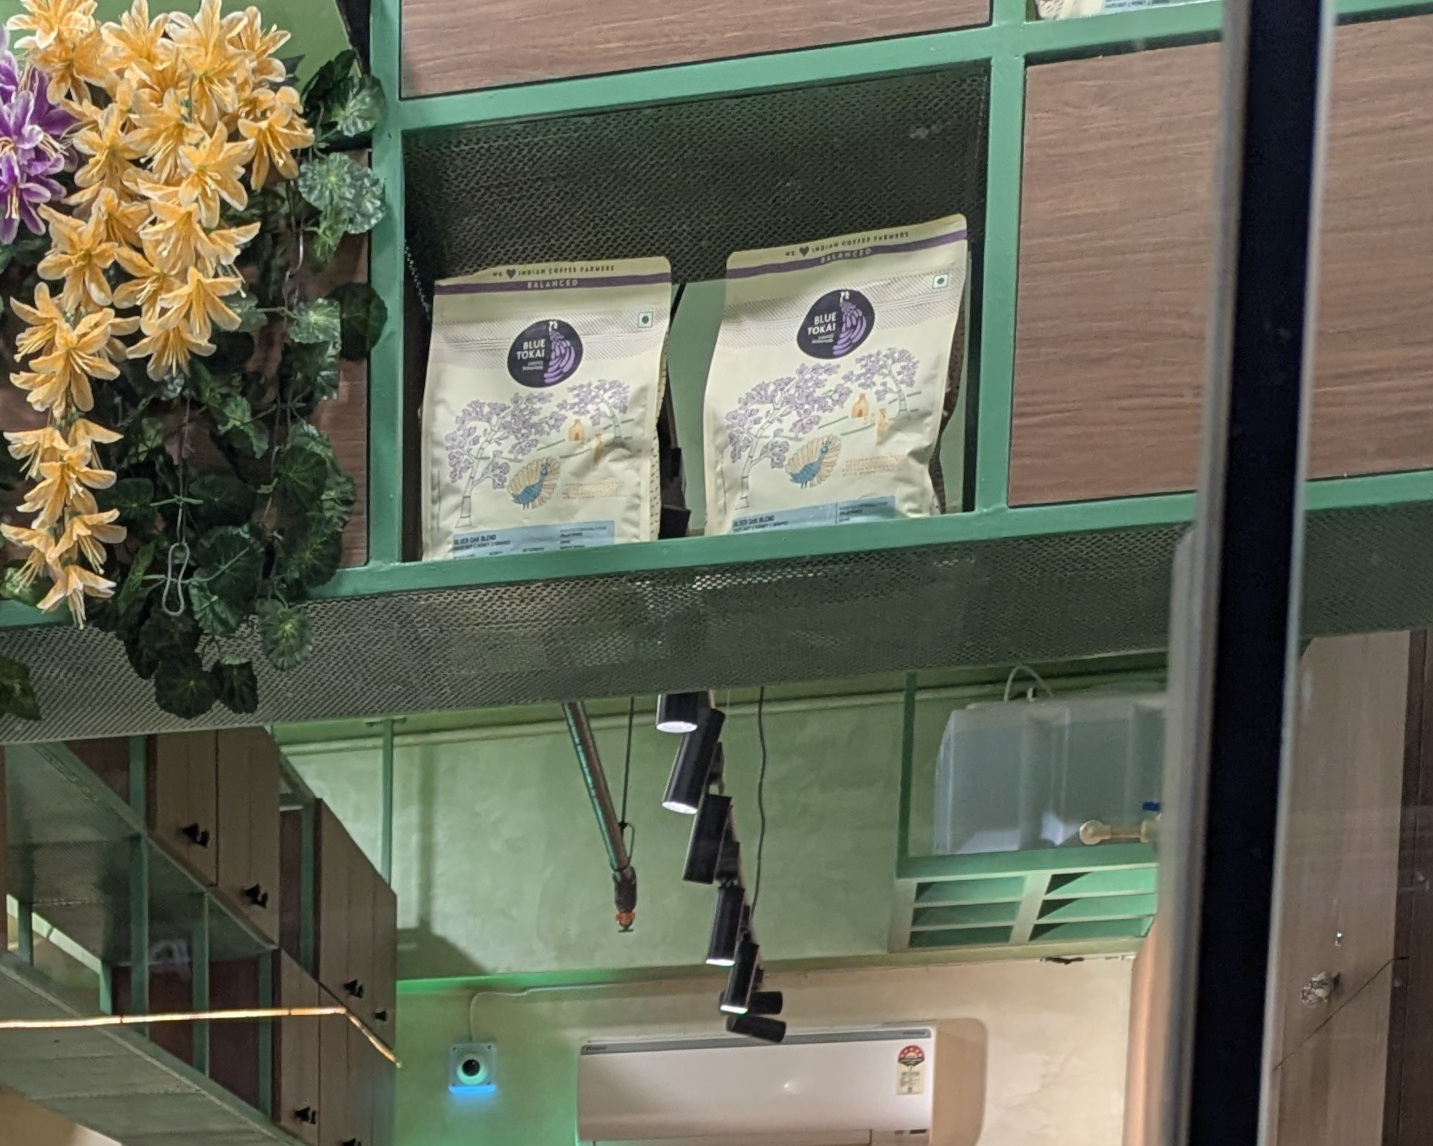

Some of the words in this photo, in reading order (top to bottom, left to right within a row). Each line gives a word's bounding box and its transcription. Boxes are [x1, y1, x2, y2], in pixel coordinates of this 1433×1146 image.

[820, 248, 872, 264] BALANCED
[518, 268, 546, 277] INDIAN
[548, 266, 577, 275] COFFEE
[580, 264, 615, 273] FARMERS
[527, 279, 579, 289] BALANCED
[814, 311, 837, 326] BLUE
[807, 323, 836, 335] TOKAI
[522, 338, 546, 350] BLUE
[516, 349, 545, 360] TOKAI
